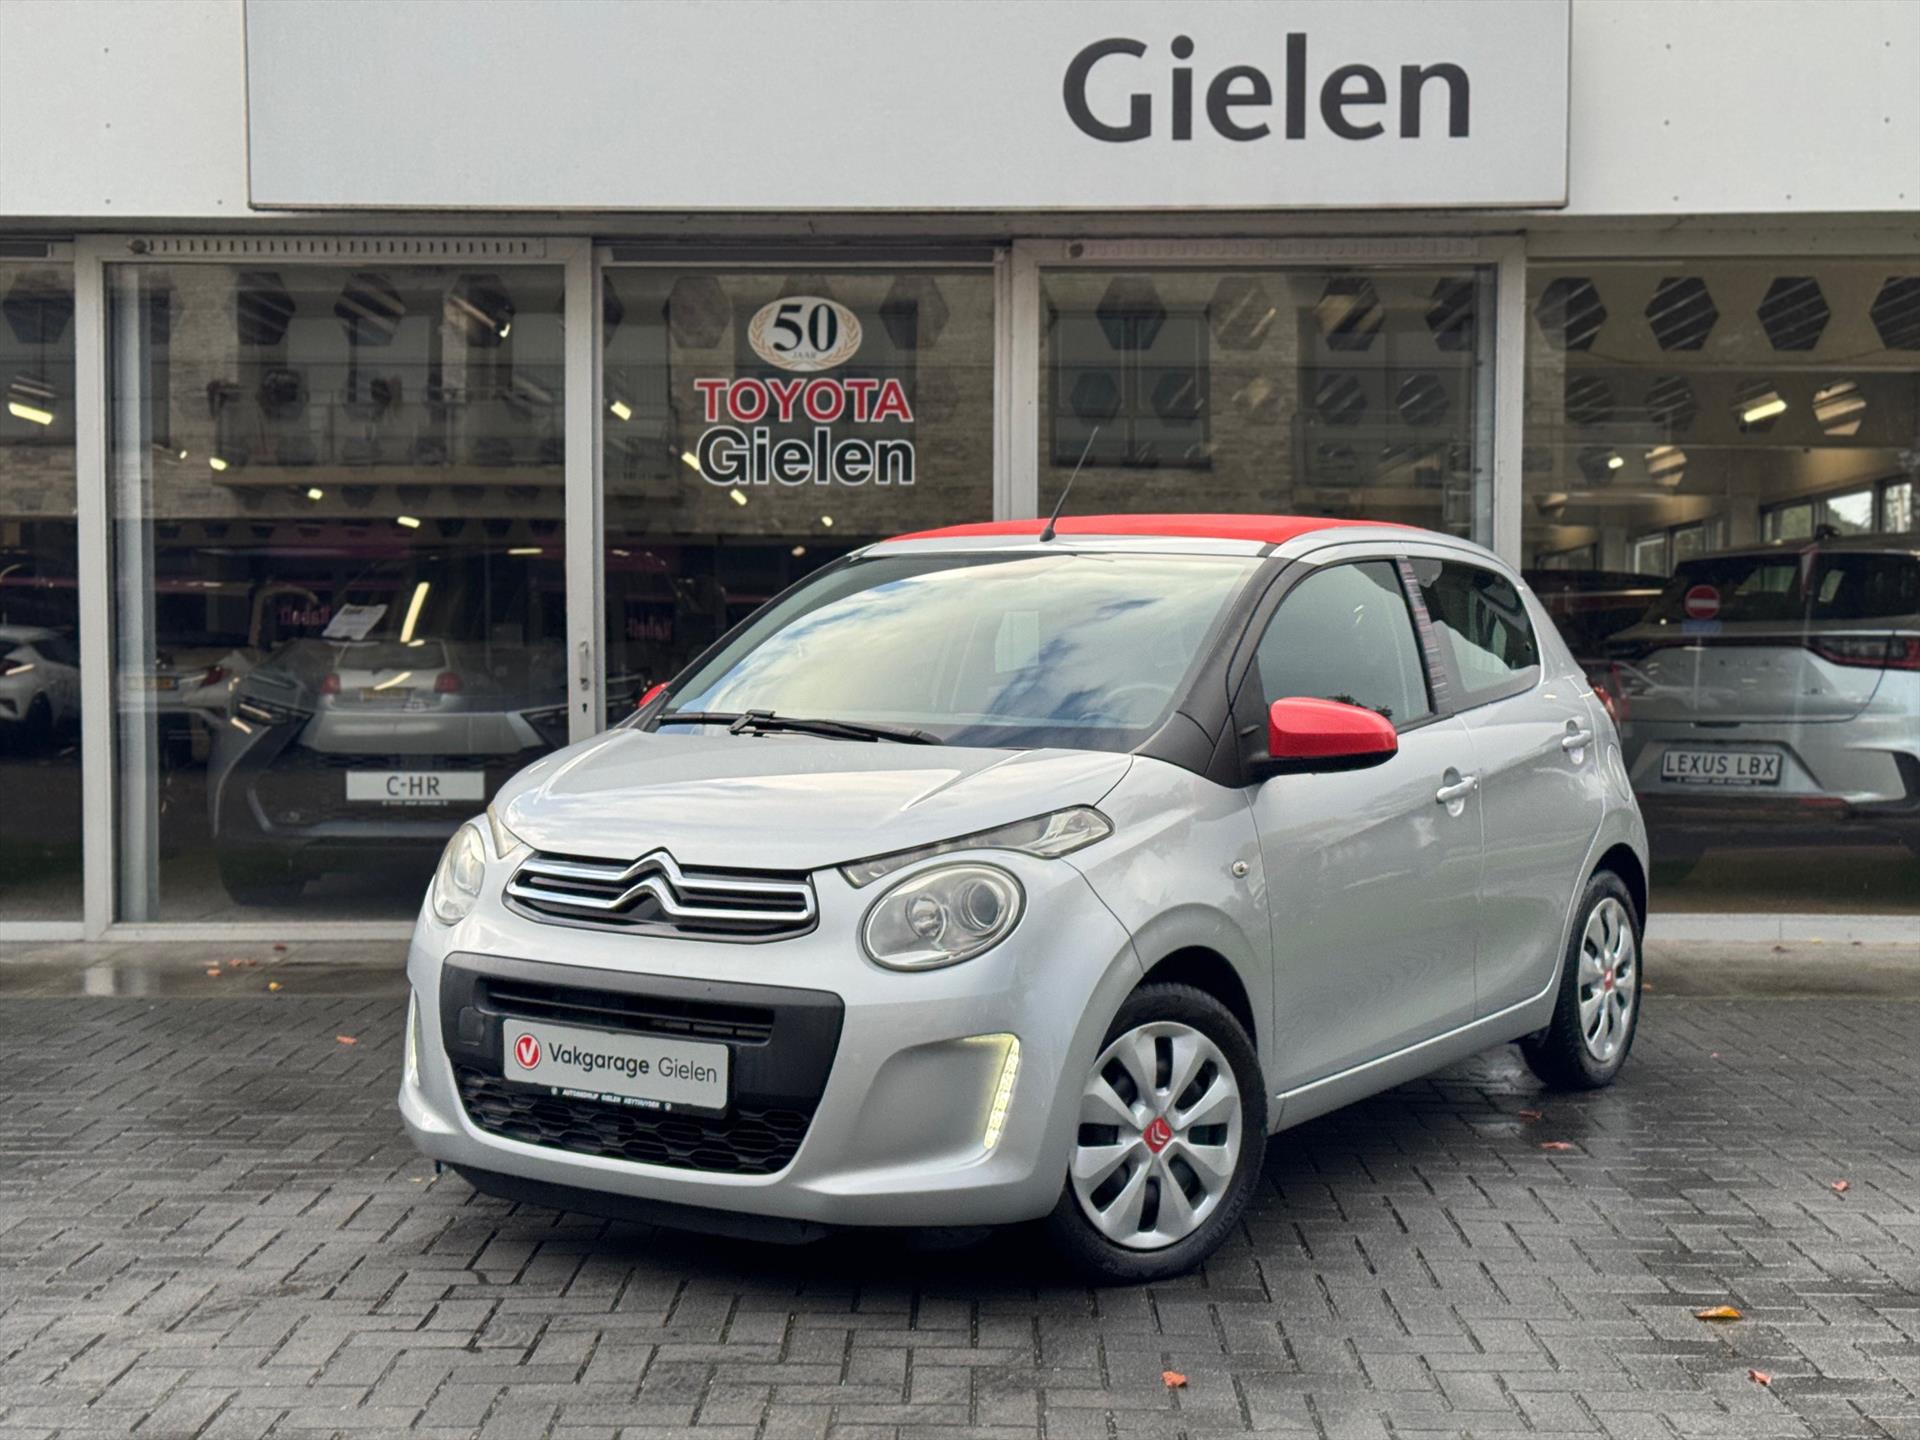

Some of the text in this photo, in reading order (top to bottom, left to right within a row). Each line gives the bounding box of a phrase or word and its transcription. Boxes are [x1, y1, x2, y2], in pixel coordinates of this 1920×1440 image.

[1062, 32, 1470, 143] Gielen
[772, 303, 838, 352] 50
[694, 378, 914, 423] TOYOTA
[697, 425, 916, 486] Gielen
[385, 775, 441, 797] C-HR
[1665, 754, 1776, 777] LEXUS LBX
[548, 1042, 718, 1084] Vakgarage Gielen
